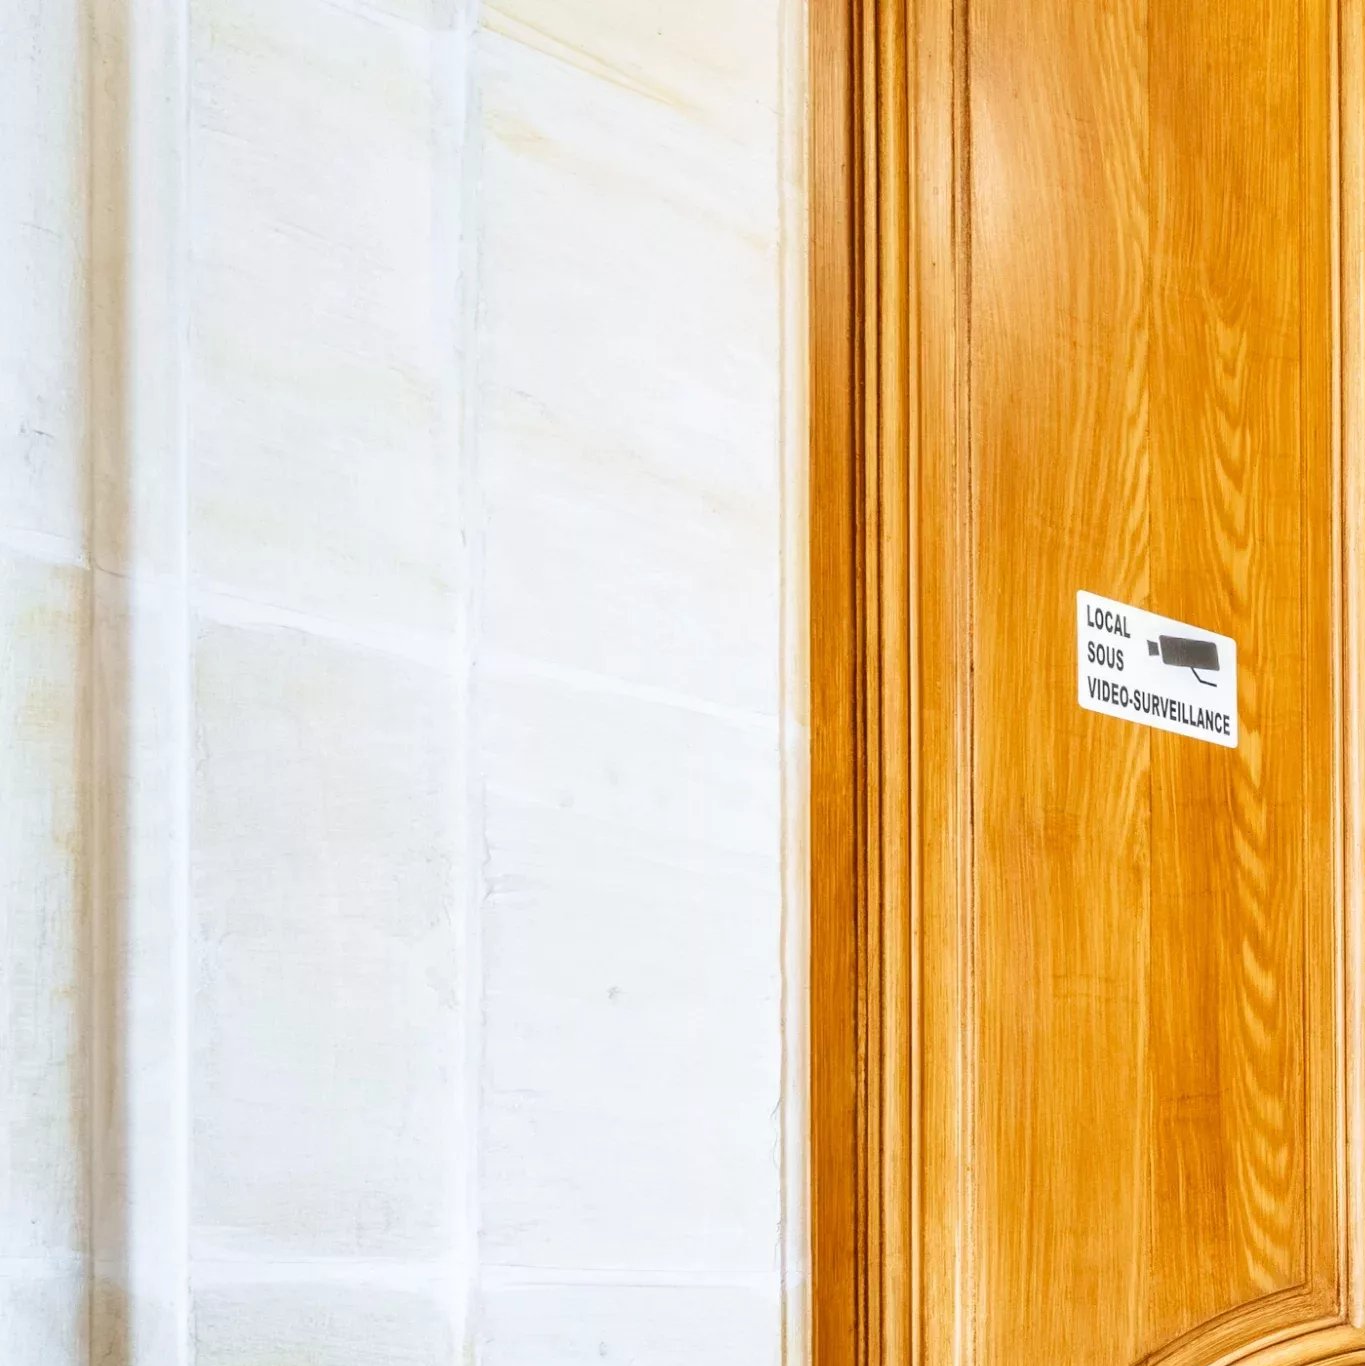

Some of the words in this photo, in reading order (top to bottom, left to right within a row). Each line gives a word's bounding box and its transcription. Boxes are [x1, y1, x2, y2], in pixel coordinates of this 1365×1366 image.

[1086, 604, 1131, 639] LOCAL
[1087, 640, 1125, 671] SOUS
[1087, 675, 1231, 736] VIDEO-SURVEILLANCE
